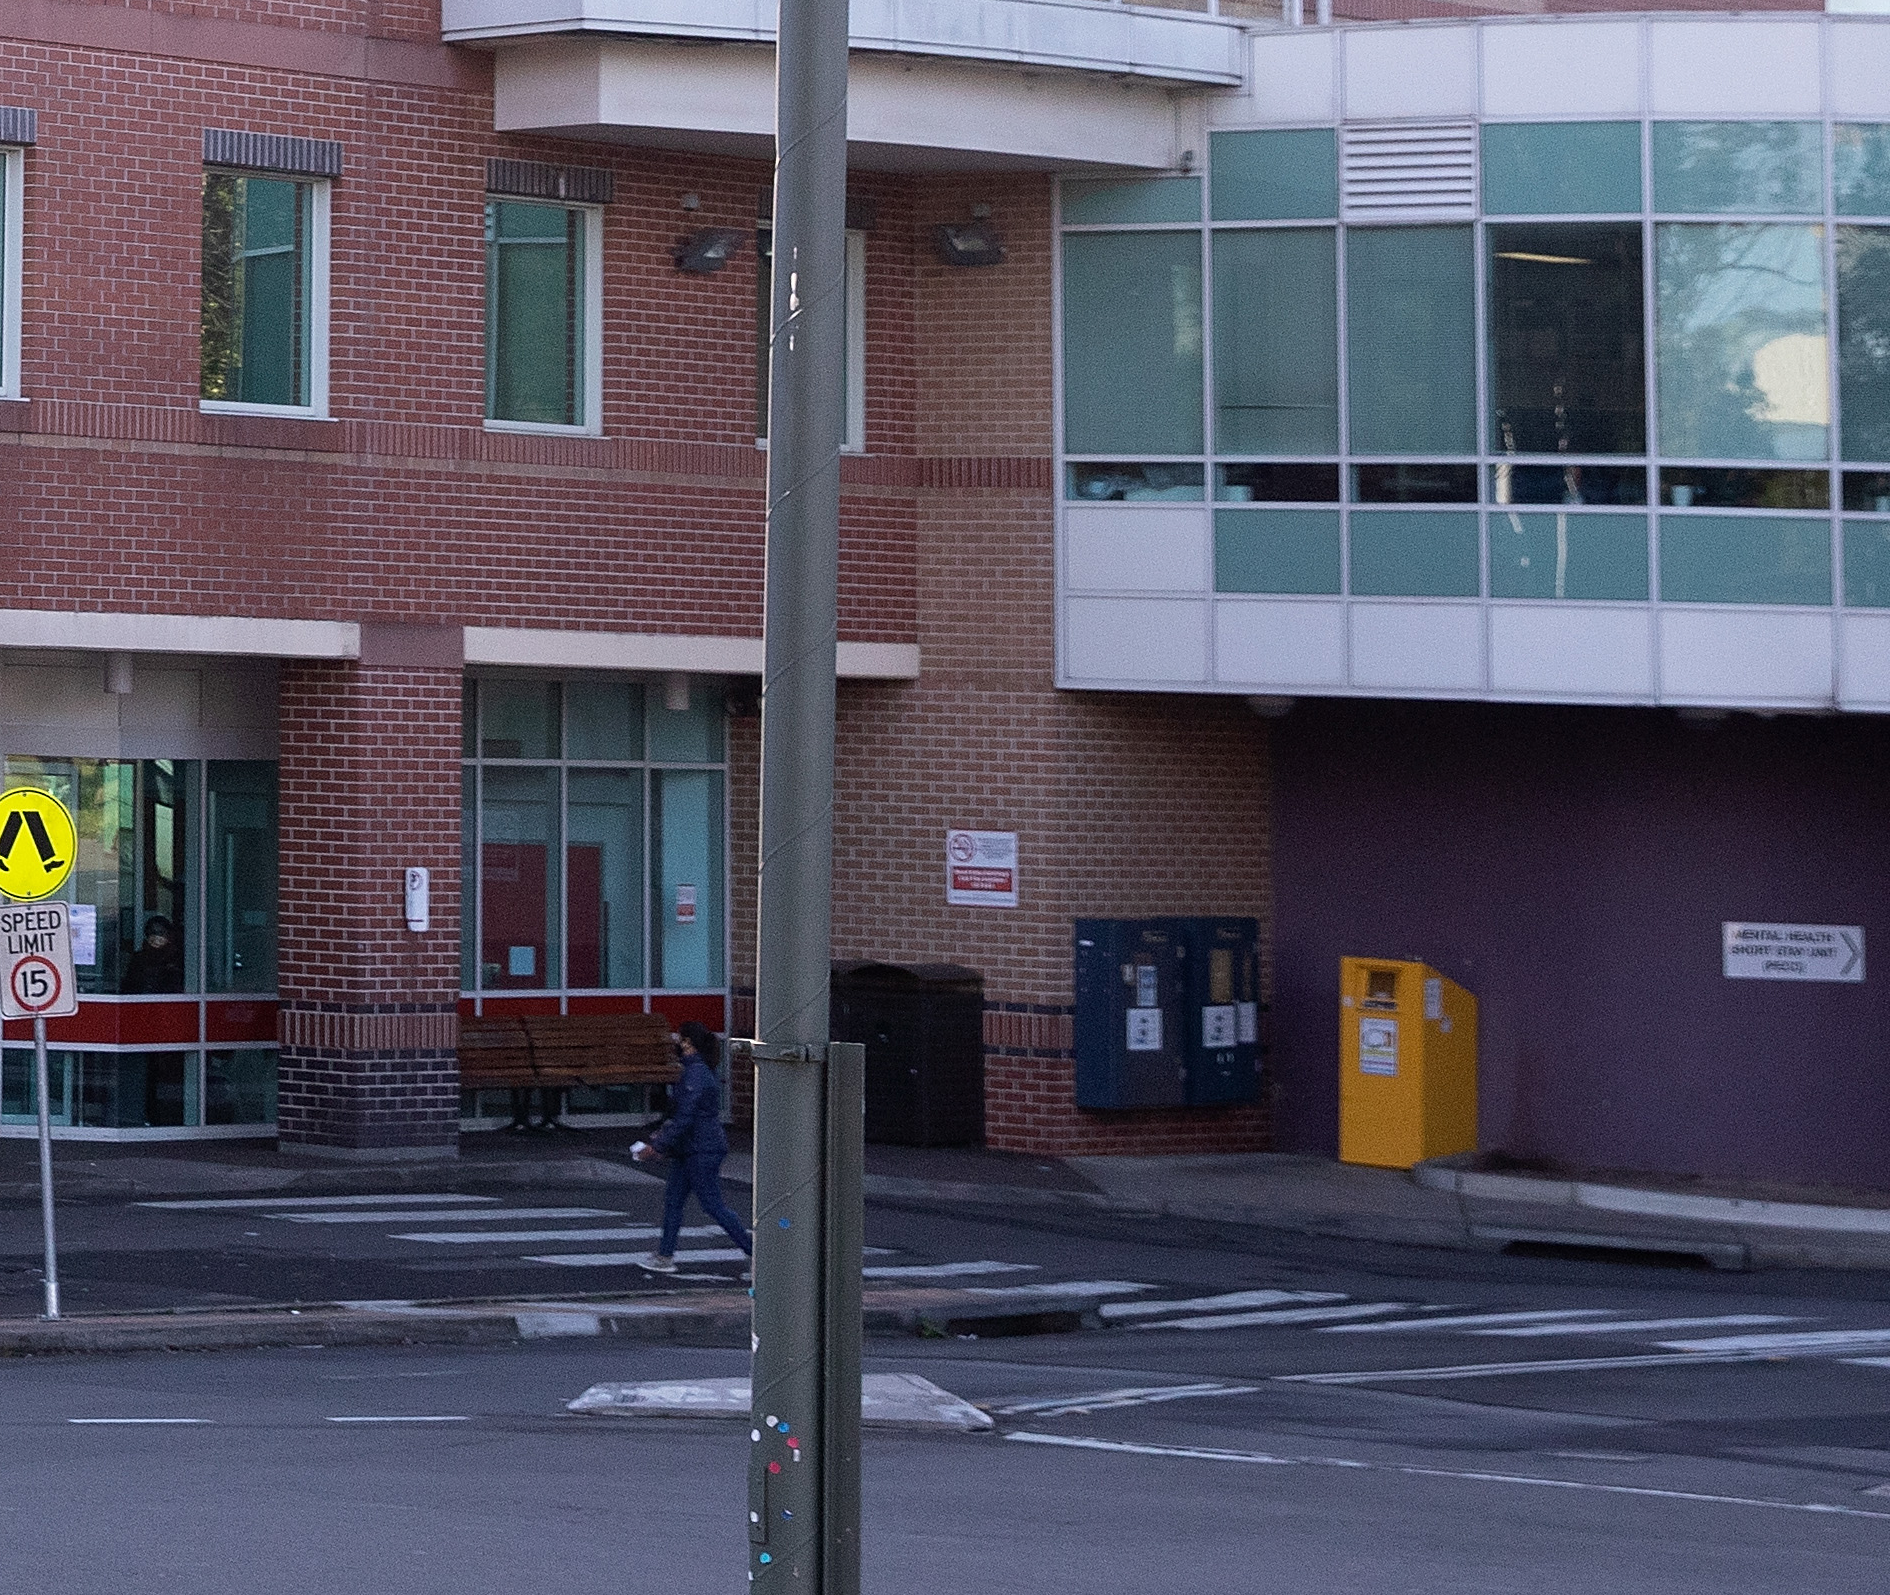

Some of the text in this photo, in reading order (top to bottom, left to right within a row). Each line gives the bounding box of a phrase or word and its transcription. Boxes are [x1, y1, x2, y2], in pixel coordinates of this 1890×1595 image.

[1, 910, 61, 933] SPEED
[7, 933, 55, 955] LIMIT
[20, 969, 48, 998] 15
